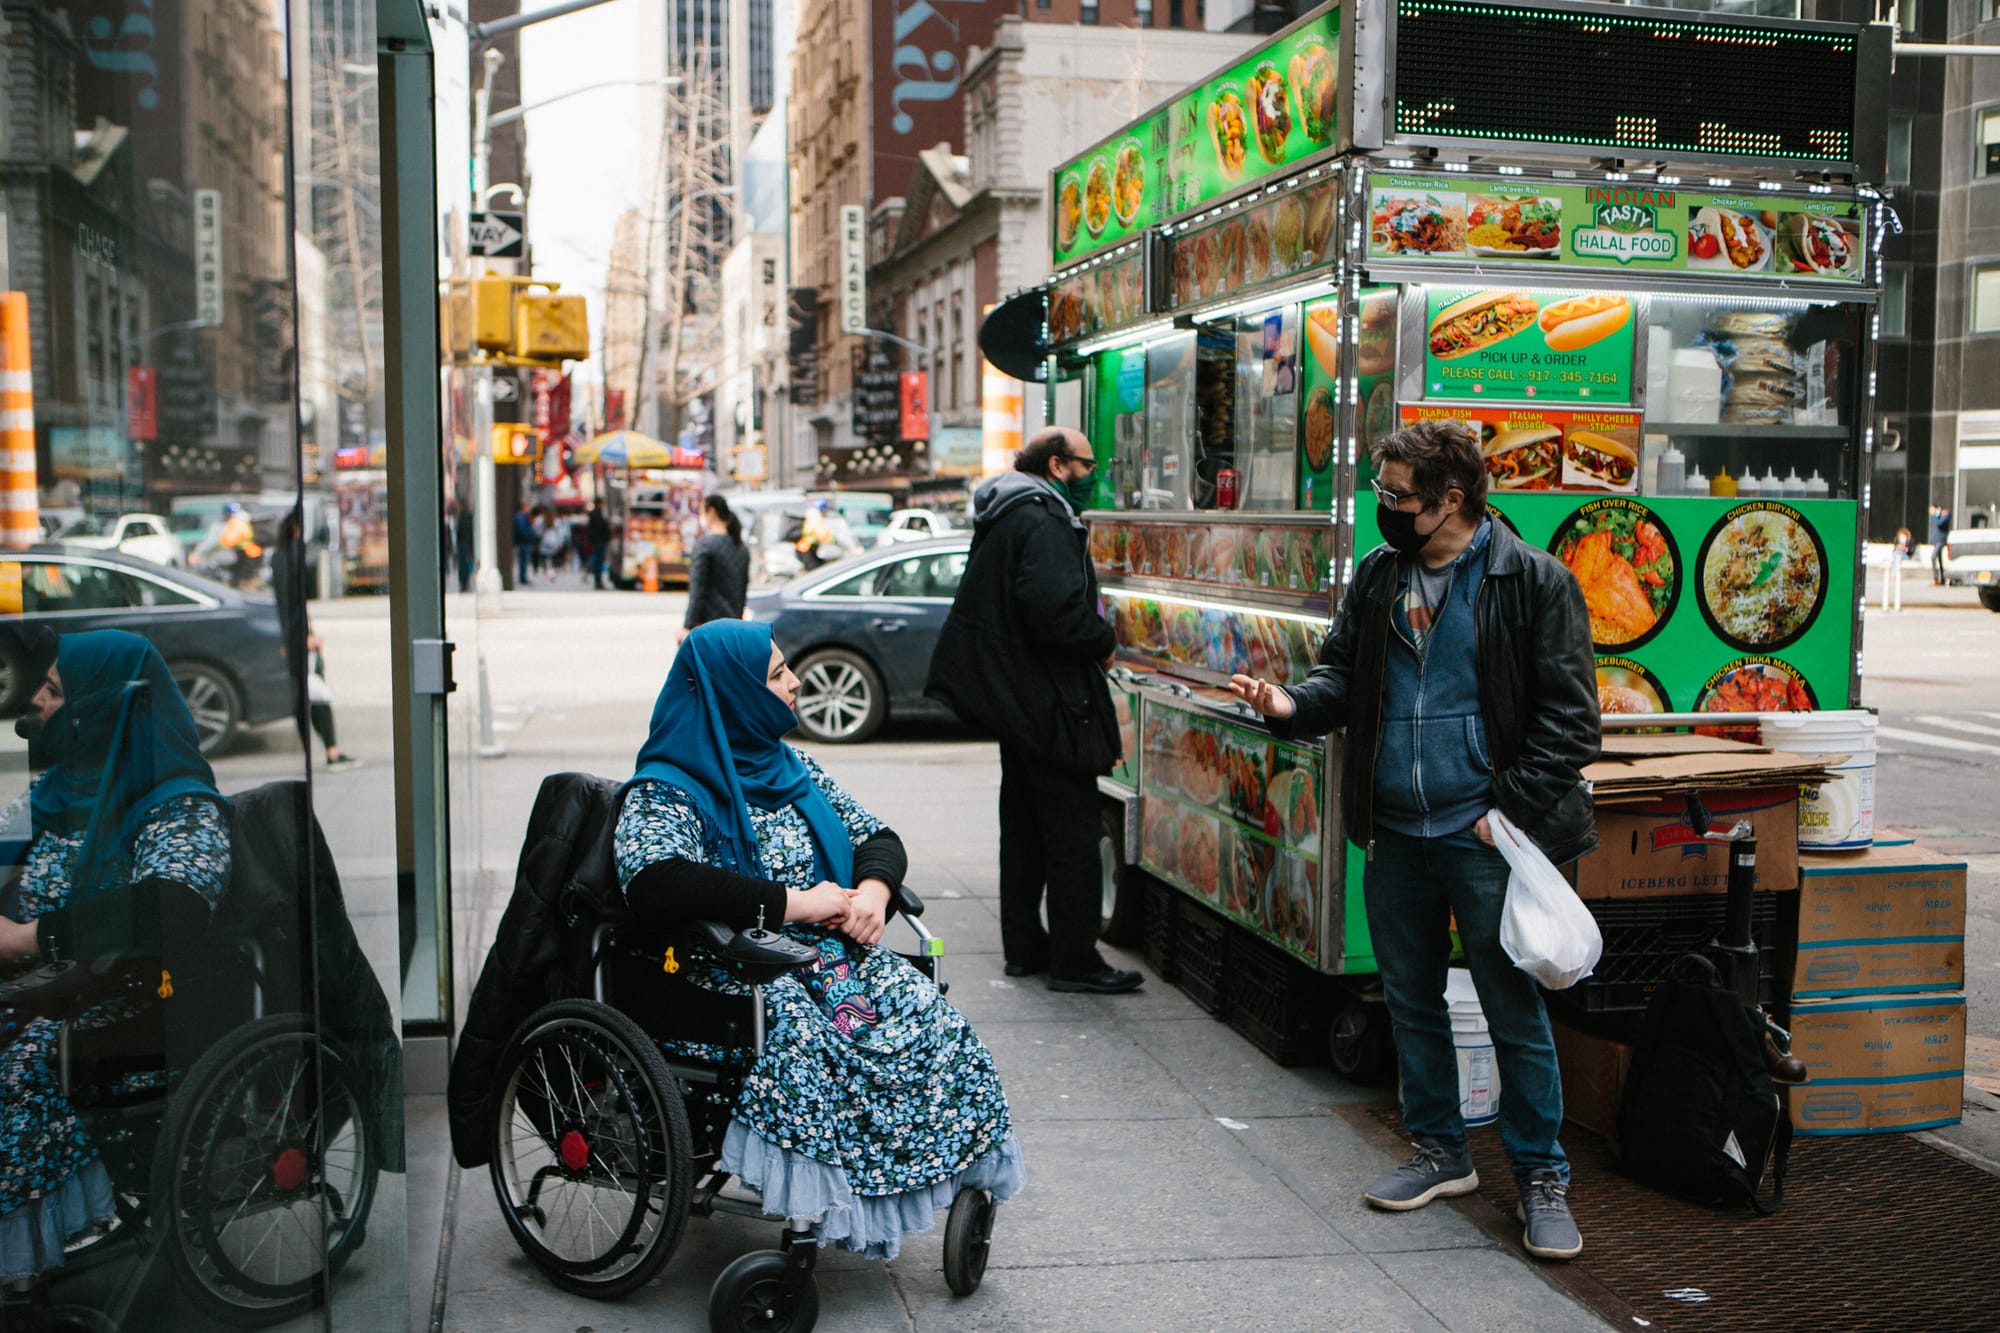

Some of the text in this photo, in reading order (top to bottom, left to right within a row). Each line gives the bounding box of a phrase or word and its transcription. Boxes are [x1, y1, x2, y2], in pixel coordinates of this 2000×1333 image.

[1389, 178, 1449, 189] Chicken over Rice
[1489, 184, 1508, 193] Lamb
[1525, 186, 1540, 194] Rice
[1588, 187, 1674, 208] INDIAN
[1712, 197, 1753, 208] Chicken Gyro
[1804, 203, 1836, 212] Lamb Gyro
[1600, 205, 1651, 228] TASTY
[1580, 235, 1671, 253] HALAL FOOD
[847, 210, 861, 329] BELASCO
[1480, 351, 1586, 366] PICK UP & ORDER
[1442, 367, 1485, 379] PLEASE
[1488, 368, 1515, 381] CALL
[1528, 370, 1550, 382] 917
[1560, 371, 1582, 382] 345
[1417, 407, 1472, 419] TILAPIA FISH
[1509, 411, 1543, 420] ITALIAN
[1572, 413, 1634, 424] PHILLY CHEESE
[1508, 420, 1546, 430] SAUSAGE
[1589, 423, 1616, 432] STEAK
[1580, 498, 1649, 517] FISH OVER RICE
[1726, 501, 1801, 521] CHICKEN BIRYANI
[1705, 656, 1807, 690] CHICKEN TIKKA MASALA
[1621, 872, 1761, 889] ICEBERG LETTE
[1864, 1040, 1892, 1050] White
